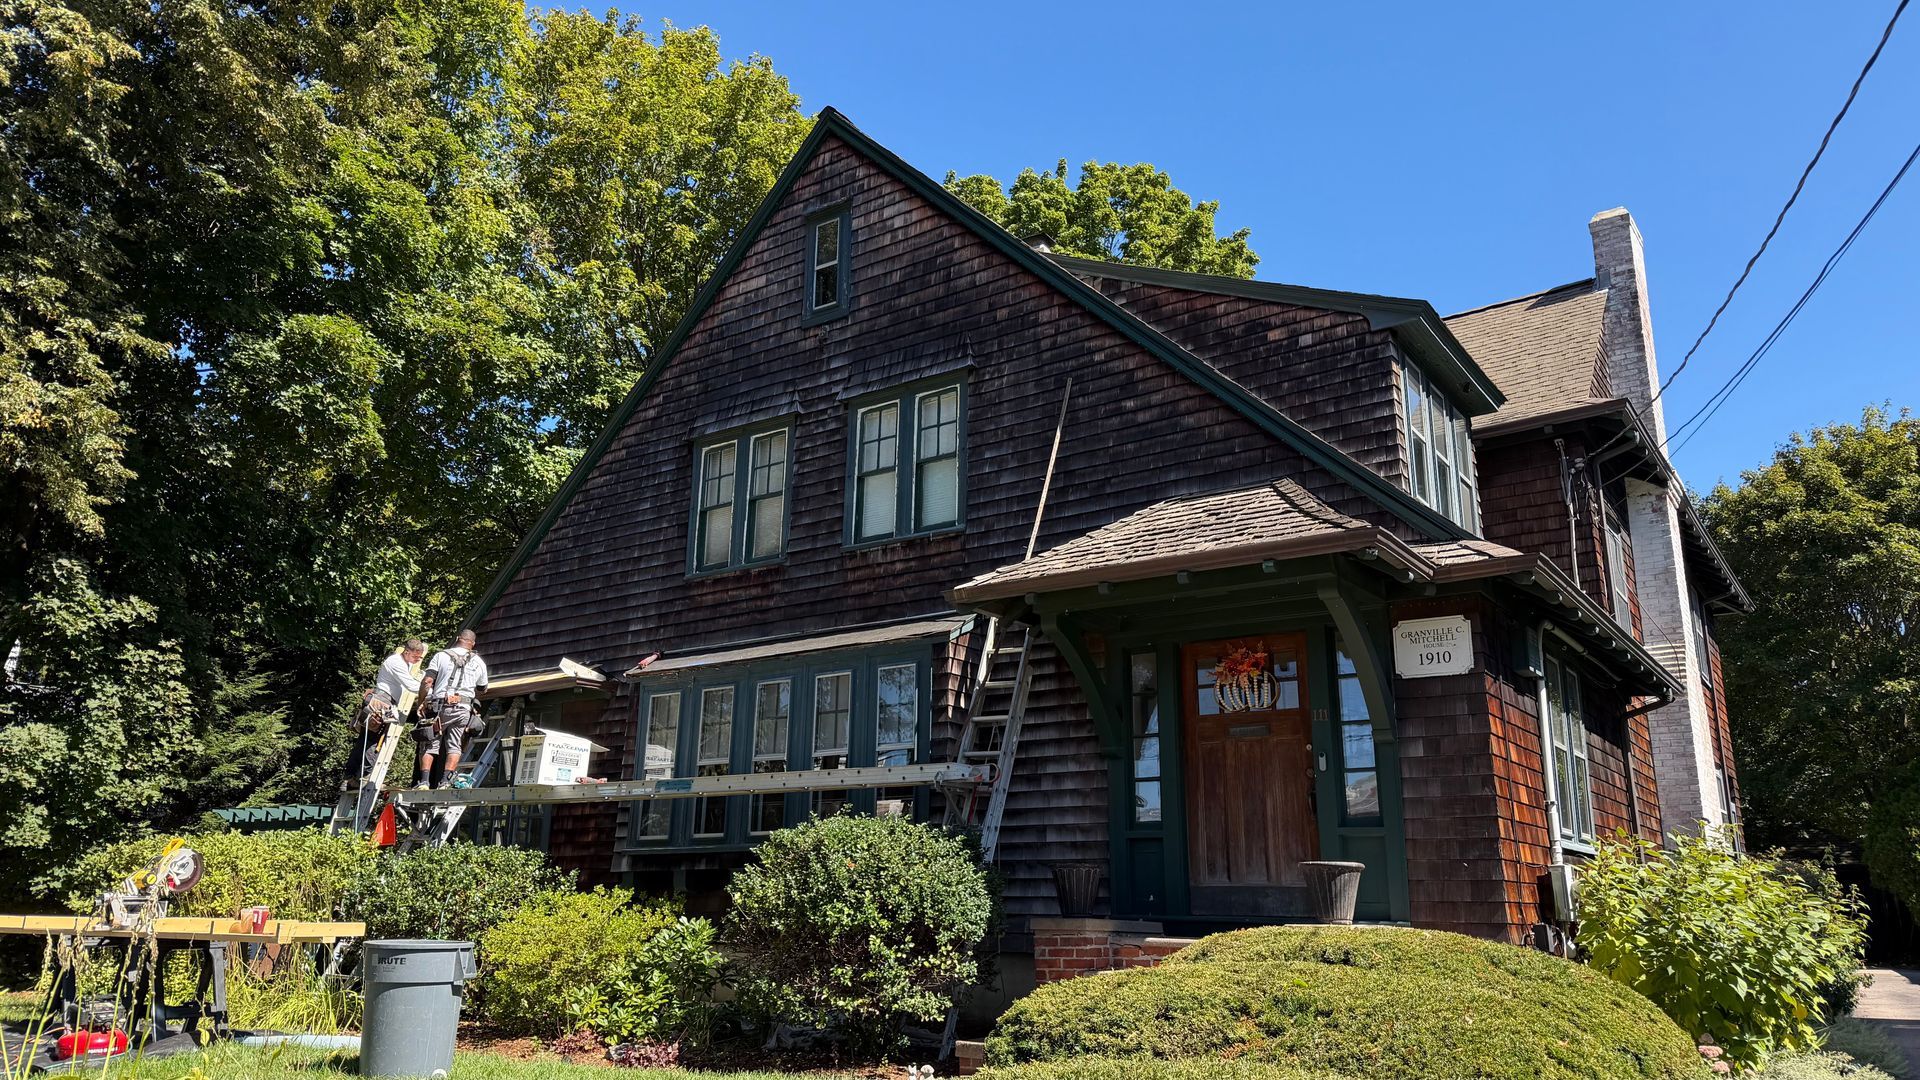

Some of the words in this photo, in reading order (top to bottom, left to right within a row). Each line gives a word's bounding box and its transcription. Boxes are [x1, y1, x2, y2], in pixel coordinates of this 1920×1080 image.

[1400, 627, 1452, 639] GRANVILLE
[1409, 634, 1457, 644] MITCHELL
[1419, 651, 1452, 665] 1910
